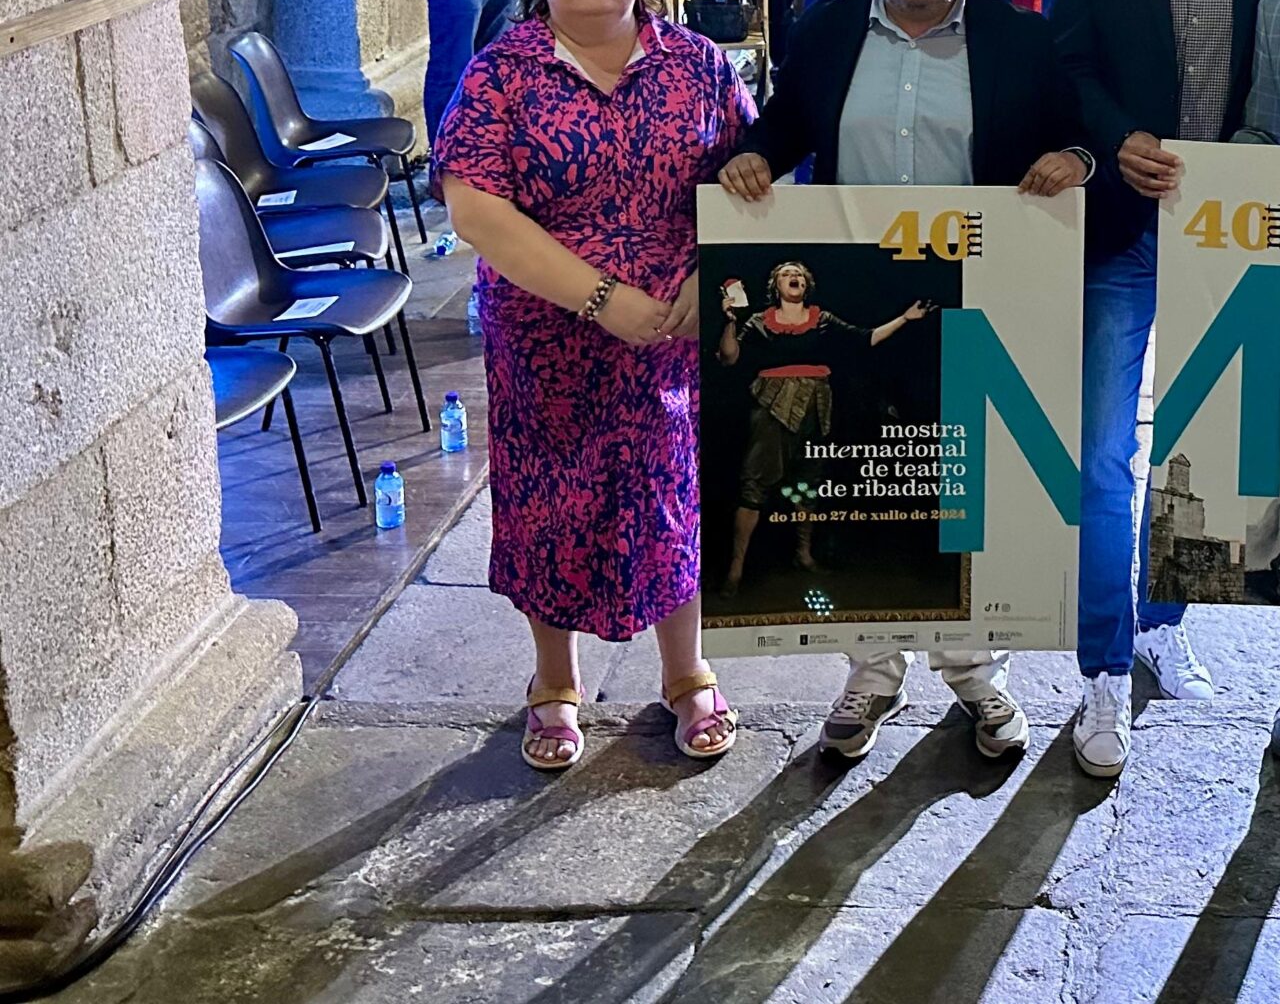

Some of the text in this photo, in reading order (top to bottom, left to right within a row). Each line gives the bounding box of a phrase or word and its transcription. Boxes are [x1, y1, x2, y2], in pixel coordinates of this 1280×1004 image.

[961, 211, 983, 258] mit
[1184, 200, 1269, 251] 40
[879, 210, 968, 261] 40
[881, 422, 967, 438] mostra
[804, 440, 967, 458] internacional
[860, 460, 966, 477] de teatro
[818, 479, 966, 497] de ribadavia
[769, 509, 967, 523] do 19 ao 27 de xullo de 2024
